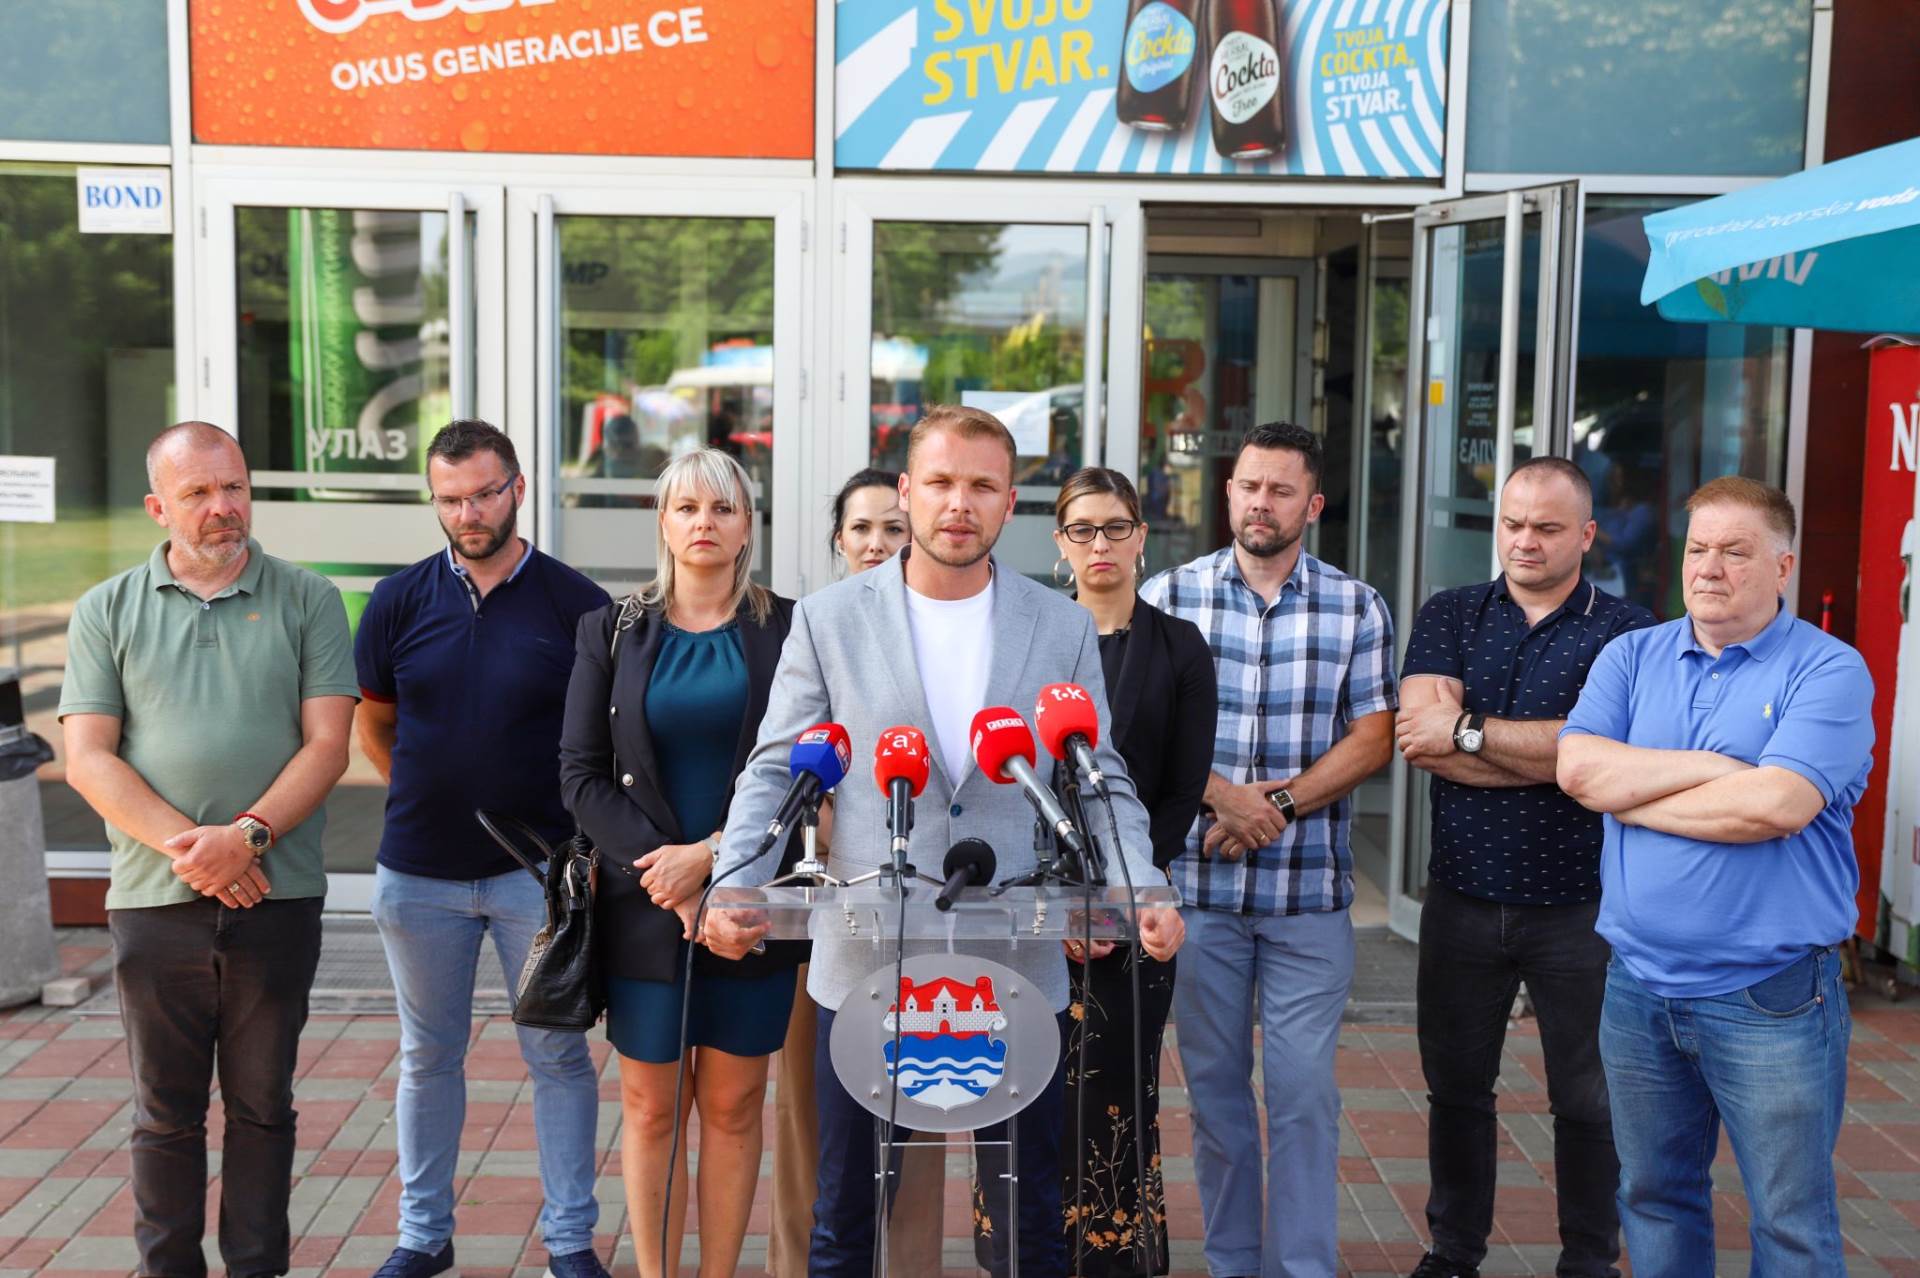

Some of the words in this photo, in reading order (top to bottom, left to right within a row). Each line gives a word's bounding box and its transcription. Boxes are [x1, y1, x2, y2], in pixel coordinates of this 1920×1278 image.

[330, 52, 428, 91] OKUS
[432, 23, 644, 78] GENERACIJE
[647, 8, 708, 48] CE
[1128, 23, 1192, 66] Cockta
[1336, 27, 1384, 49] TVOJA
[923, 29, 1109, 106] STVAR.
[1216, 52, 1276, 100] Cockta
[1338, 70, 1389, 94] TVOJA
[1325, 88, 1407, 121] STVAR.
[86, 185, 162, 208] BOND
[307, 428, 407, 461] УЛАЗ
